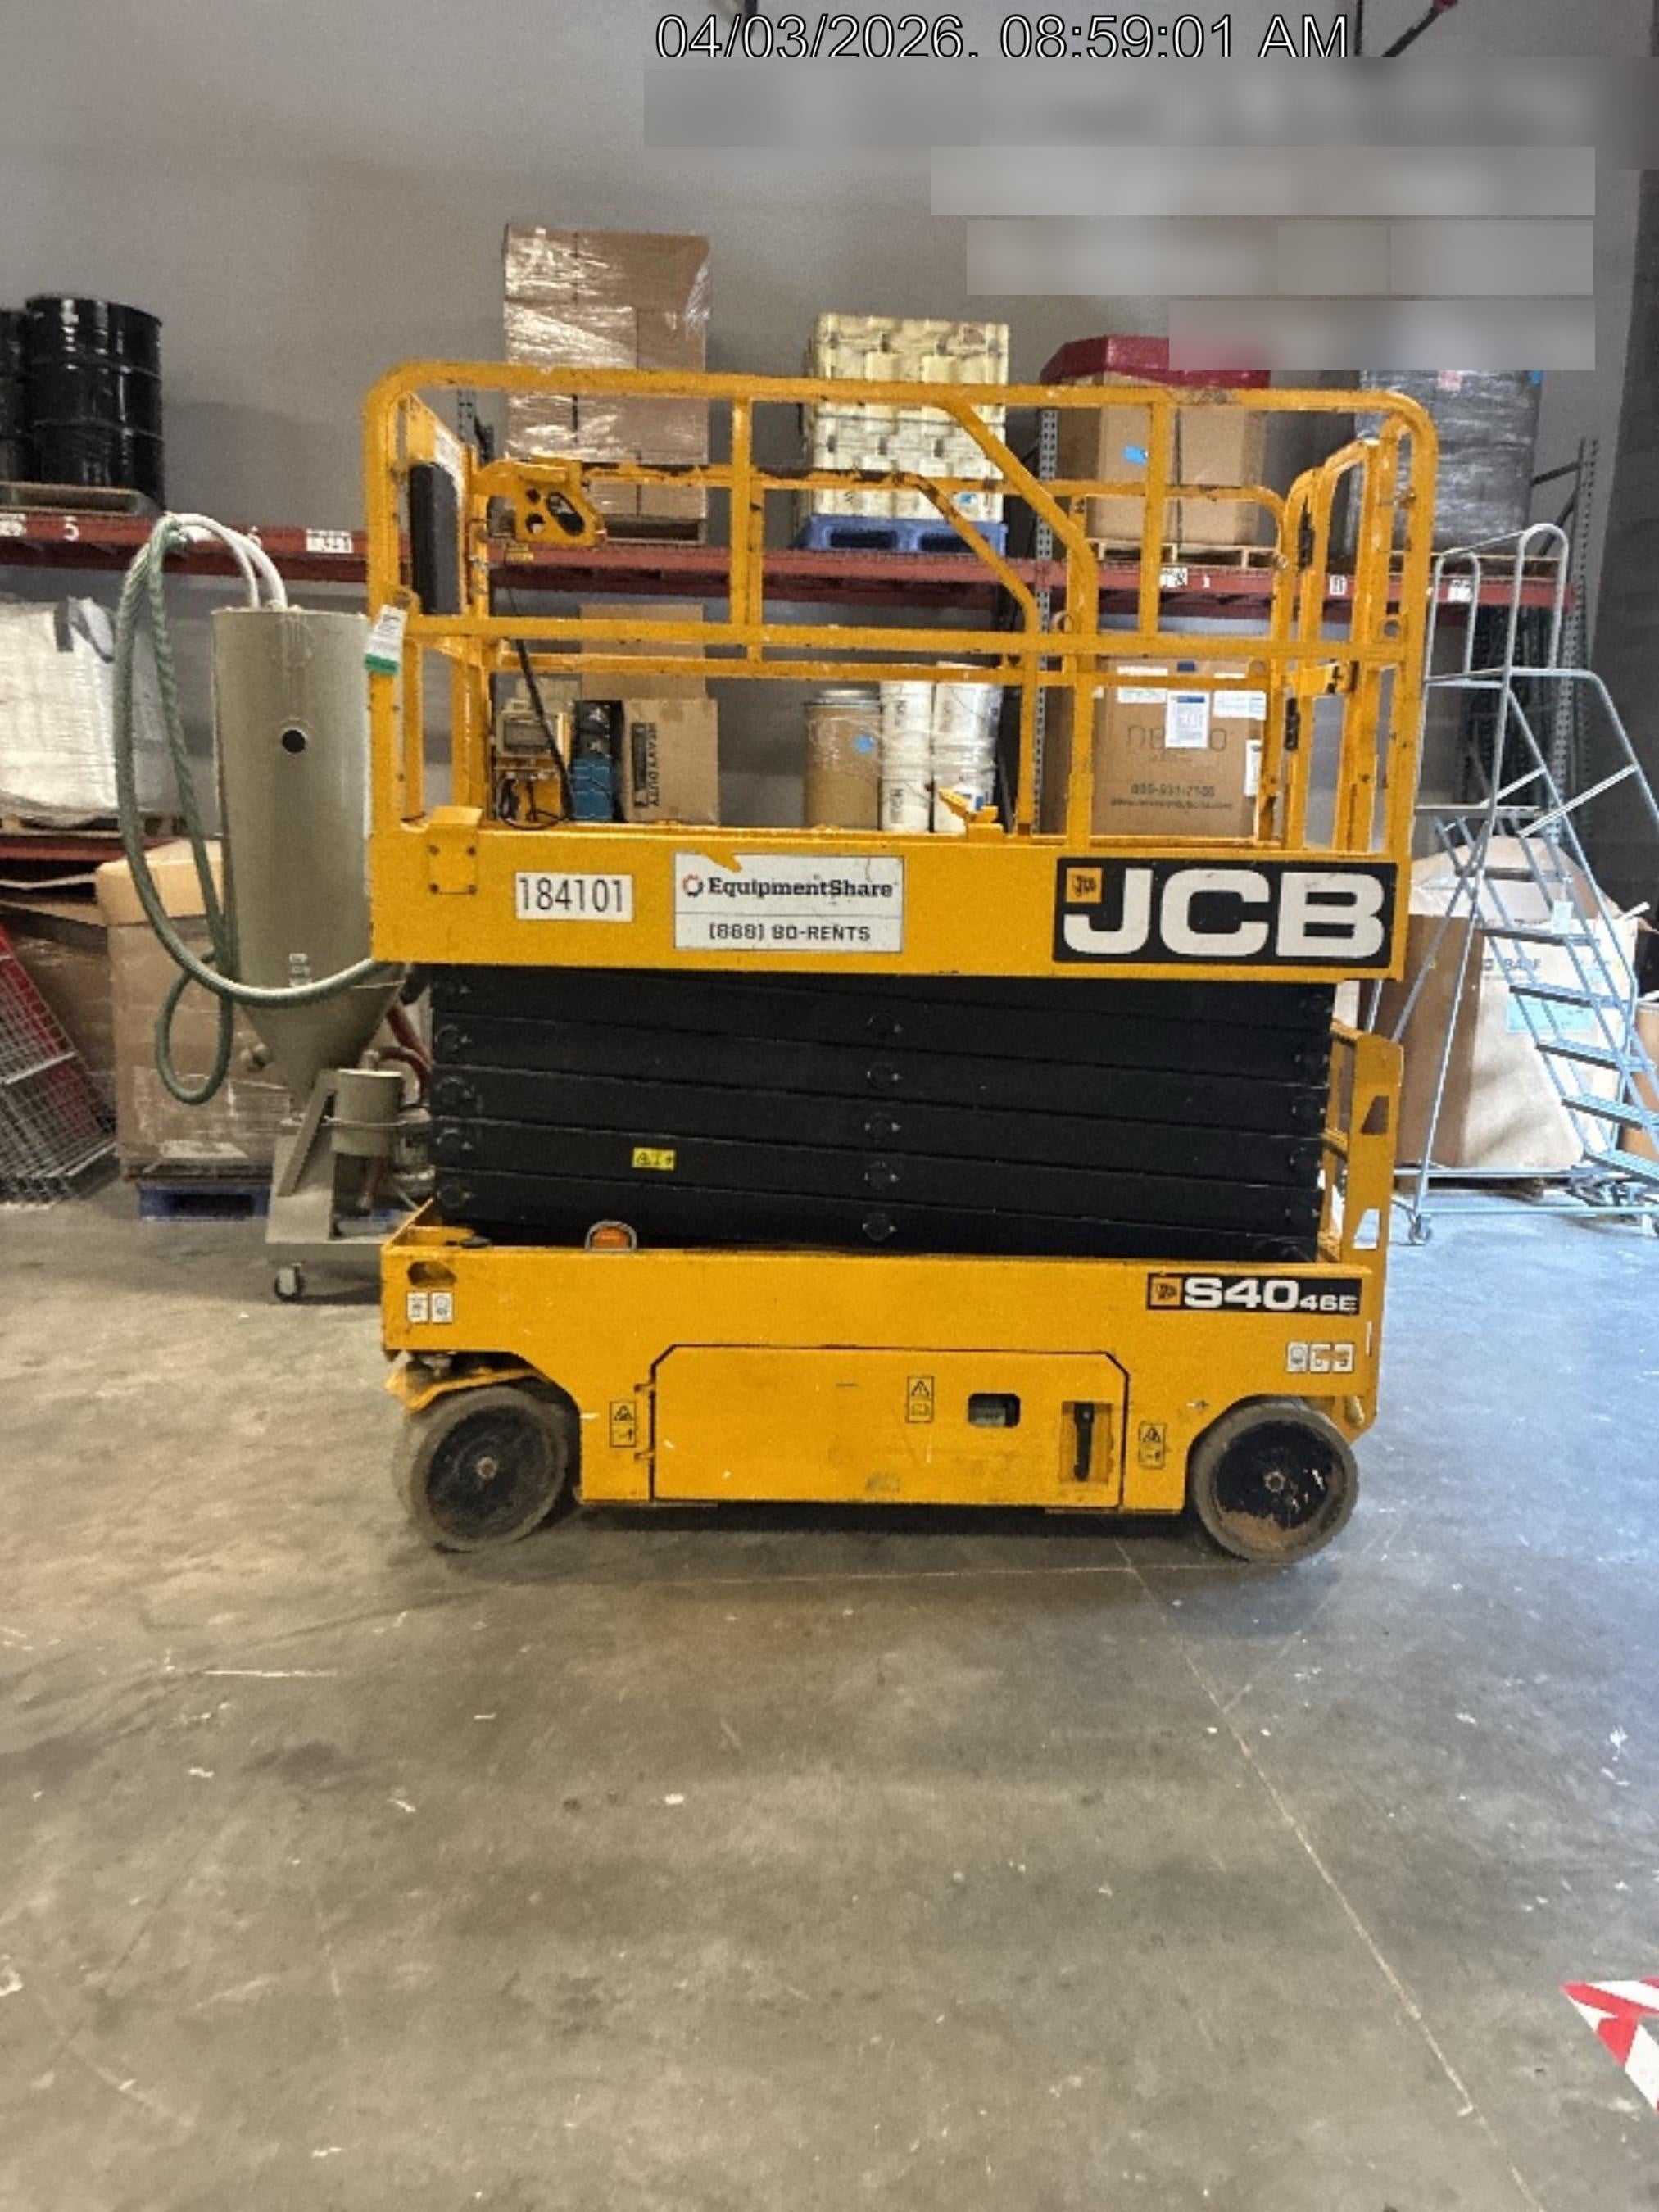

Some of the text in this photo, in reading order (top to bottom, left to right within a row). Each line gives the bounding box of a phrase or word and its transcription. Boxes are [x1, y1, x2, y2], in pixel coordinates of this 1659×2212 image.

[519, 877, 623, 912] 184101
[708, 877, 893, 898] EquipmentShare
[1063, 868, 1385, 959] JCB
